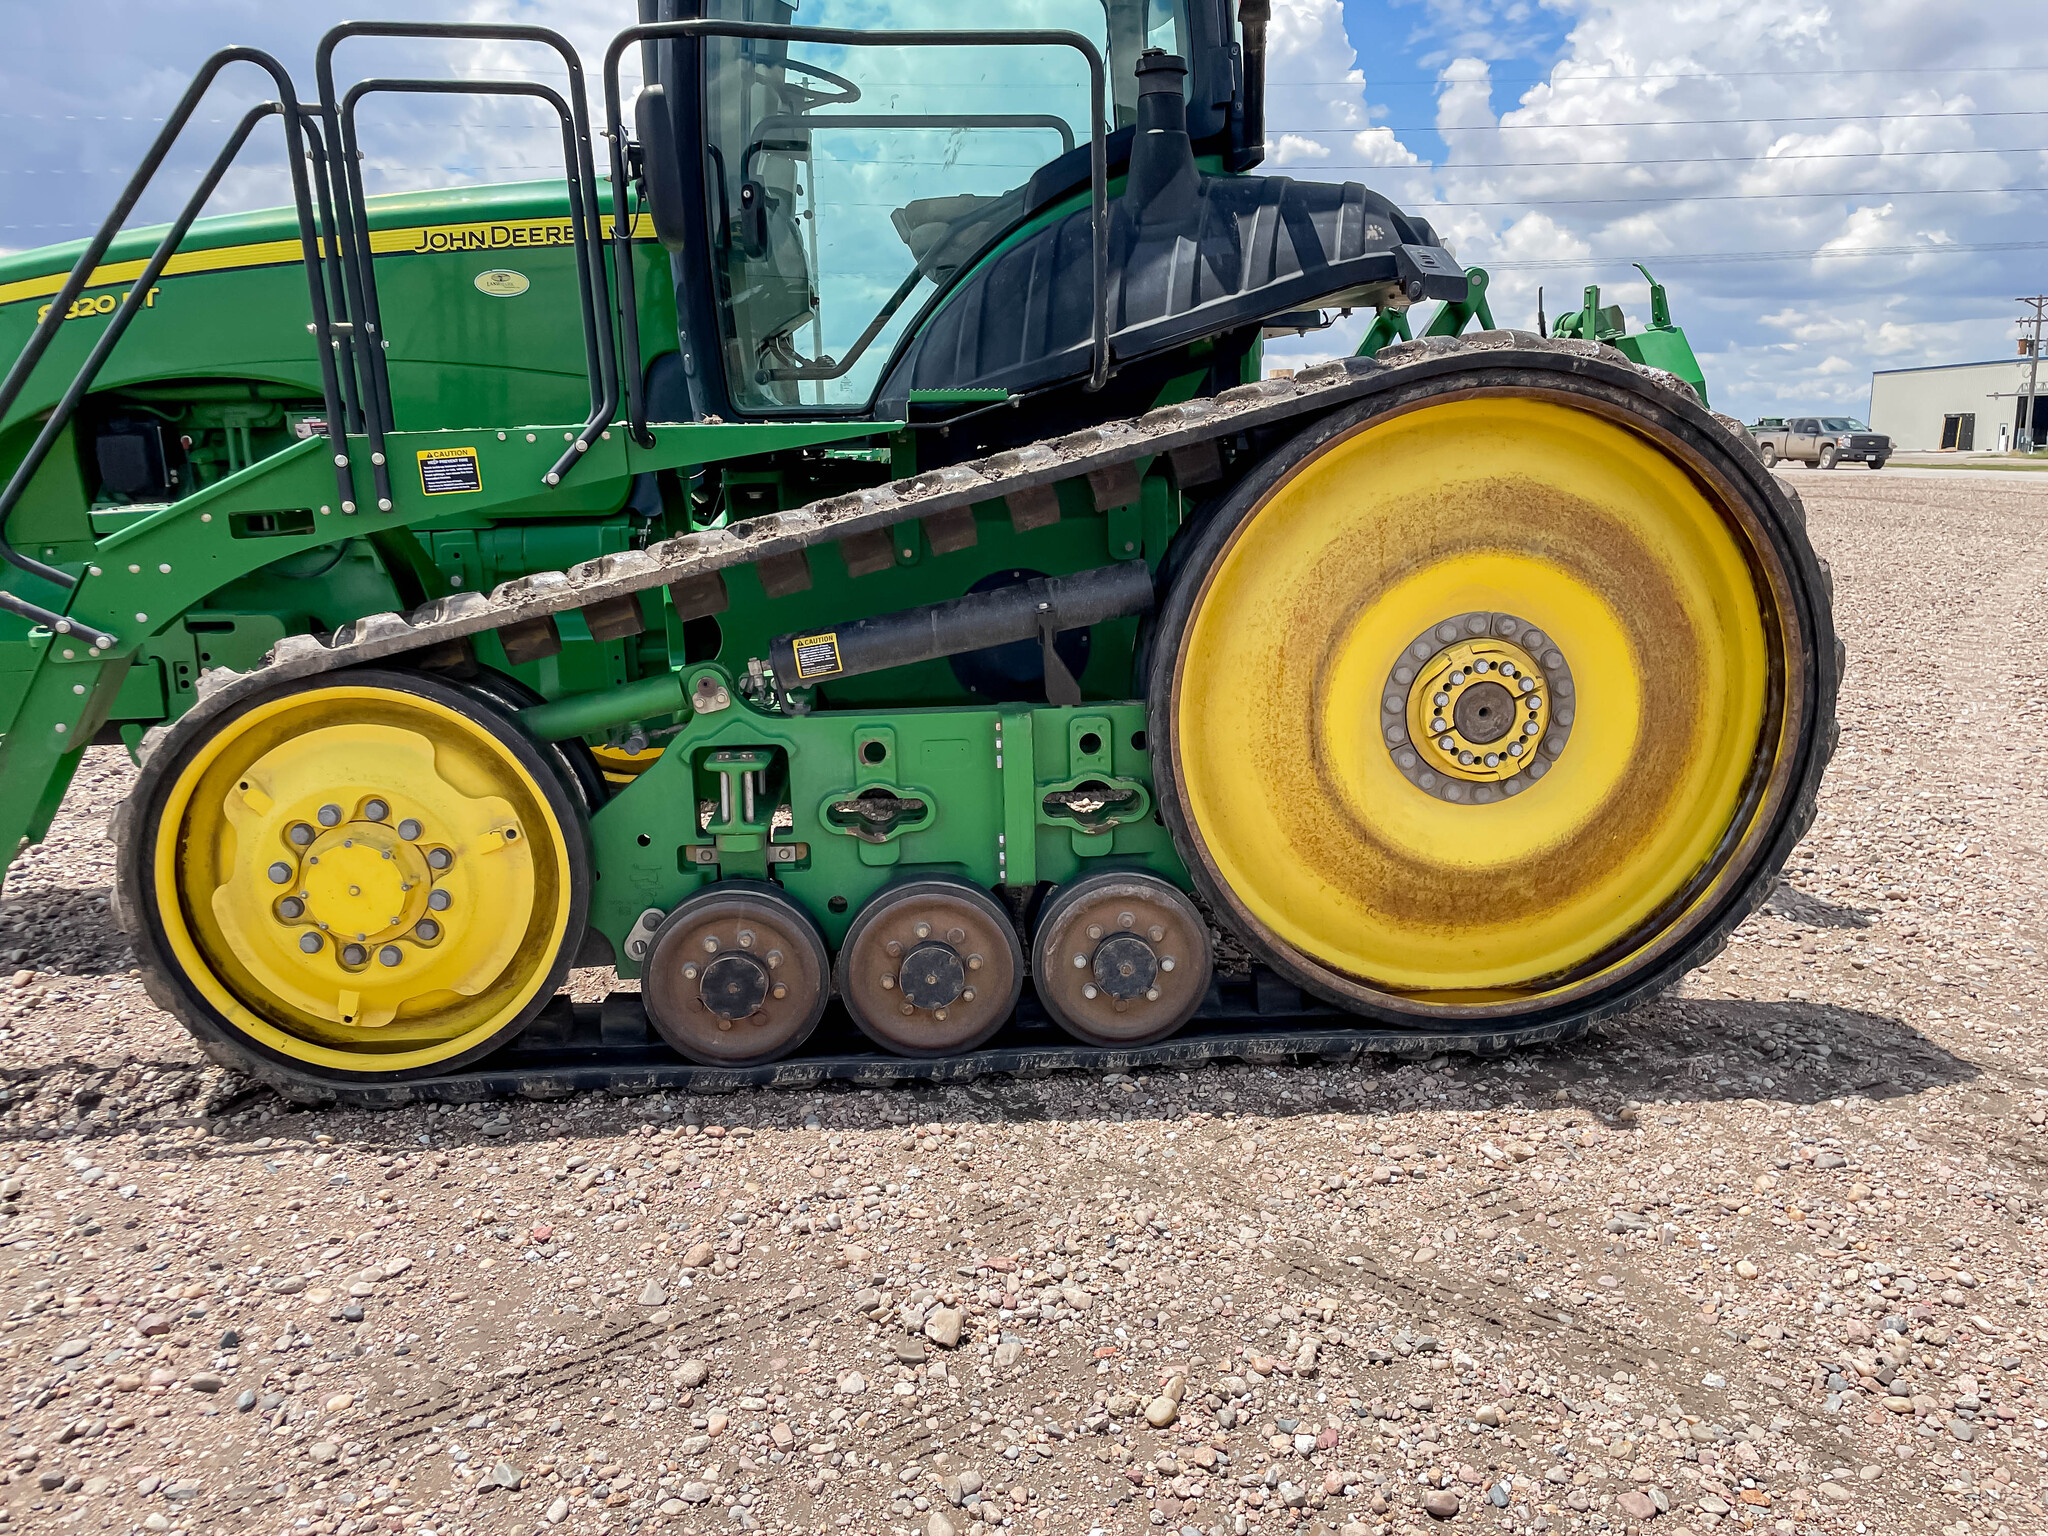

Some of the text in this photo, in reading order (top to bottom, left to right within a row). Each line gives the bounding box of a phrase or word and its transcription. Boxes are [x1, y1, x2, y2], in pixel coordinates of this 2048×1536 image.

[415, 226, 574, 250] JOHN DEERE
[804, 635, 833, 645] CAUTION
